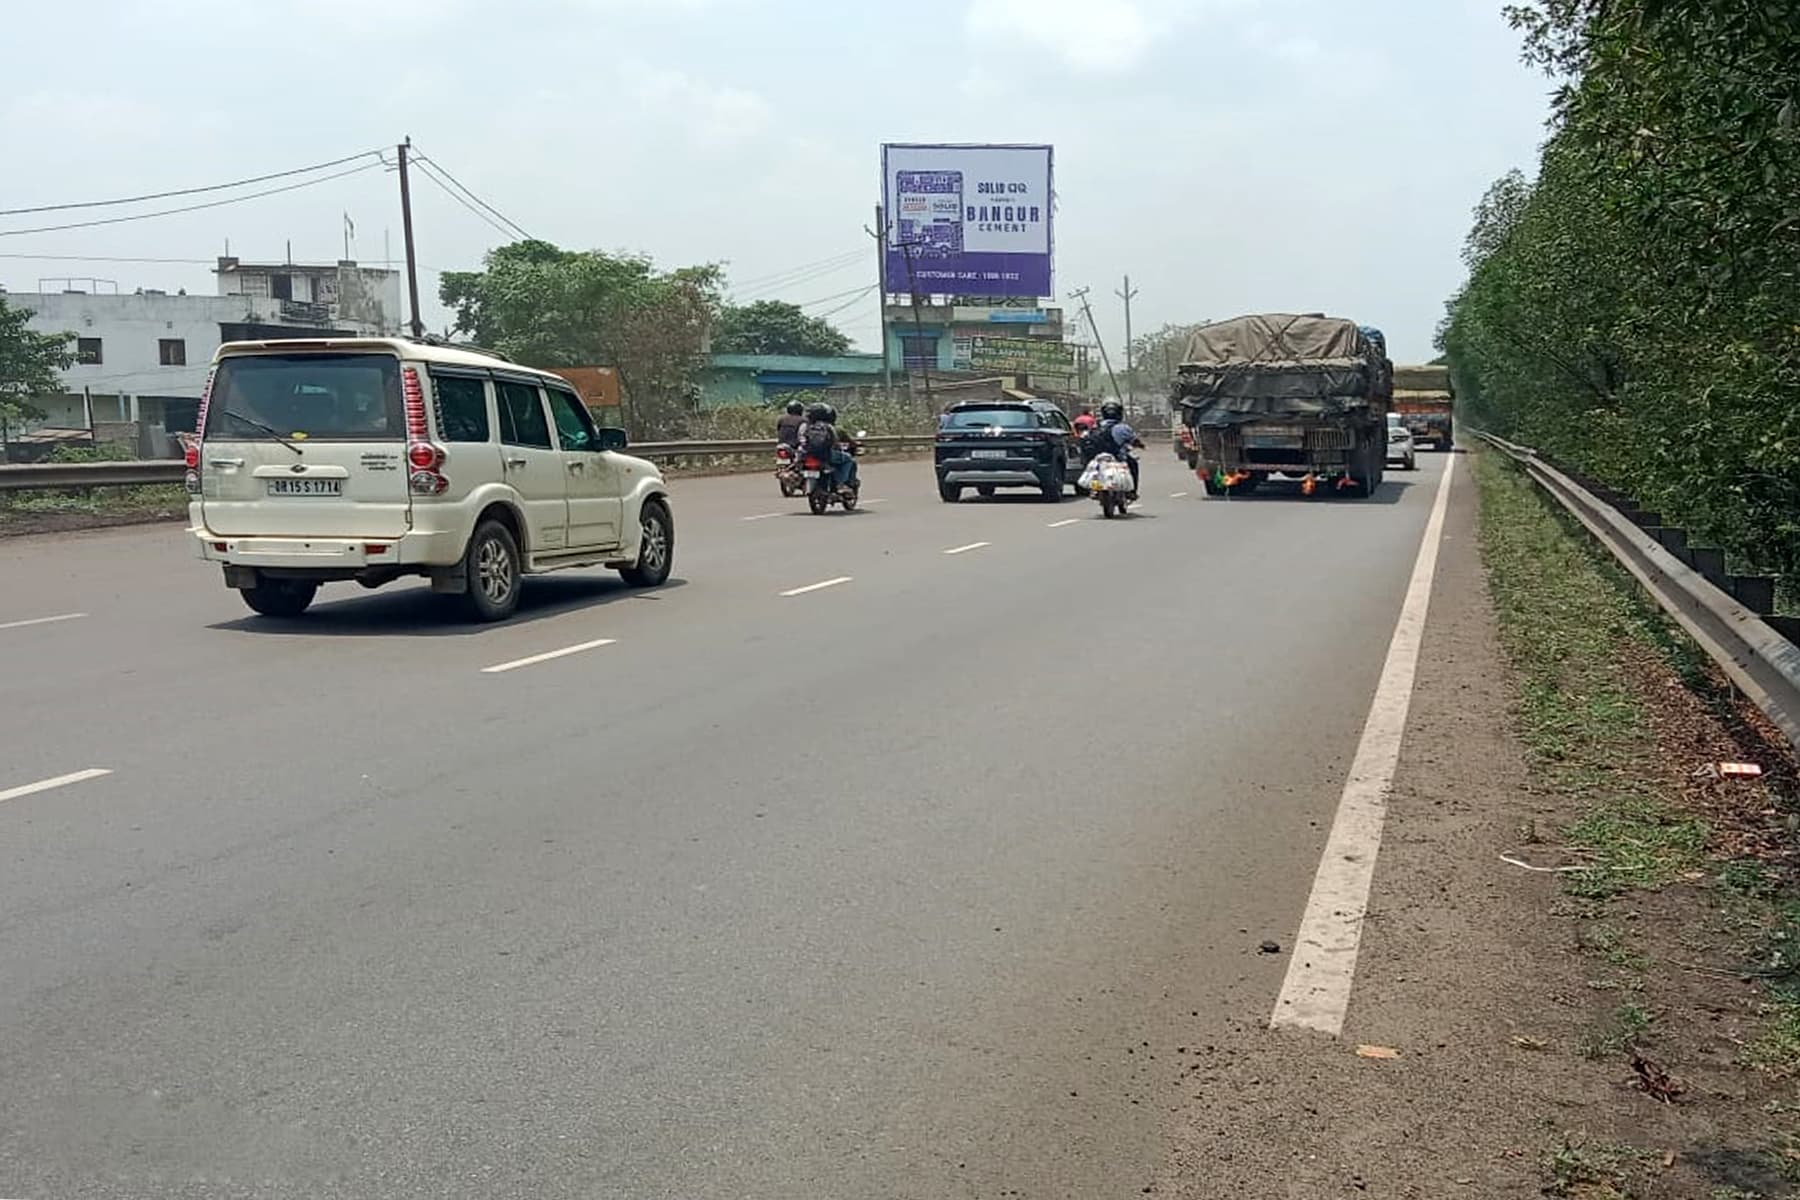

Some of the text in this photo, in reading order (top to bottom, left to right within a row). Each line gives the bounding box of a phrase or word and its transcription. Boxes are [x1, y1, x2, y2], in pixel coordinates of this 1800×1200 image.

[977, 182, 1005, 194] SOLID
[967, 206, 1040, 222] BANGUR
[978, 223, 1026, 233] CEMENT
